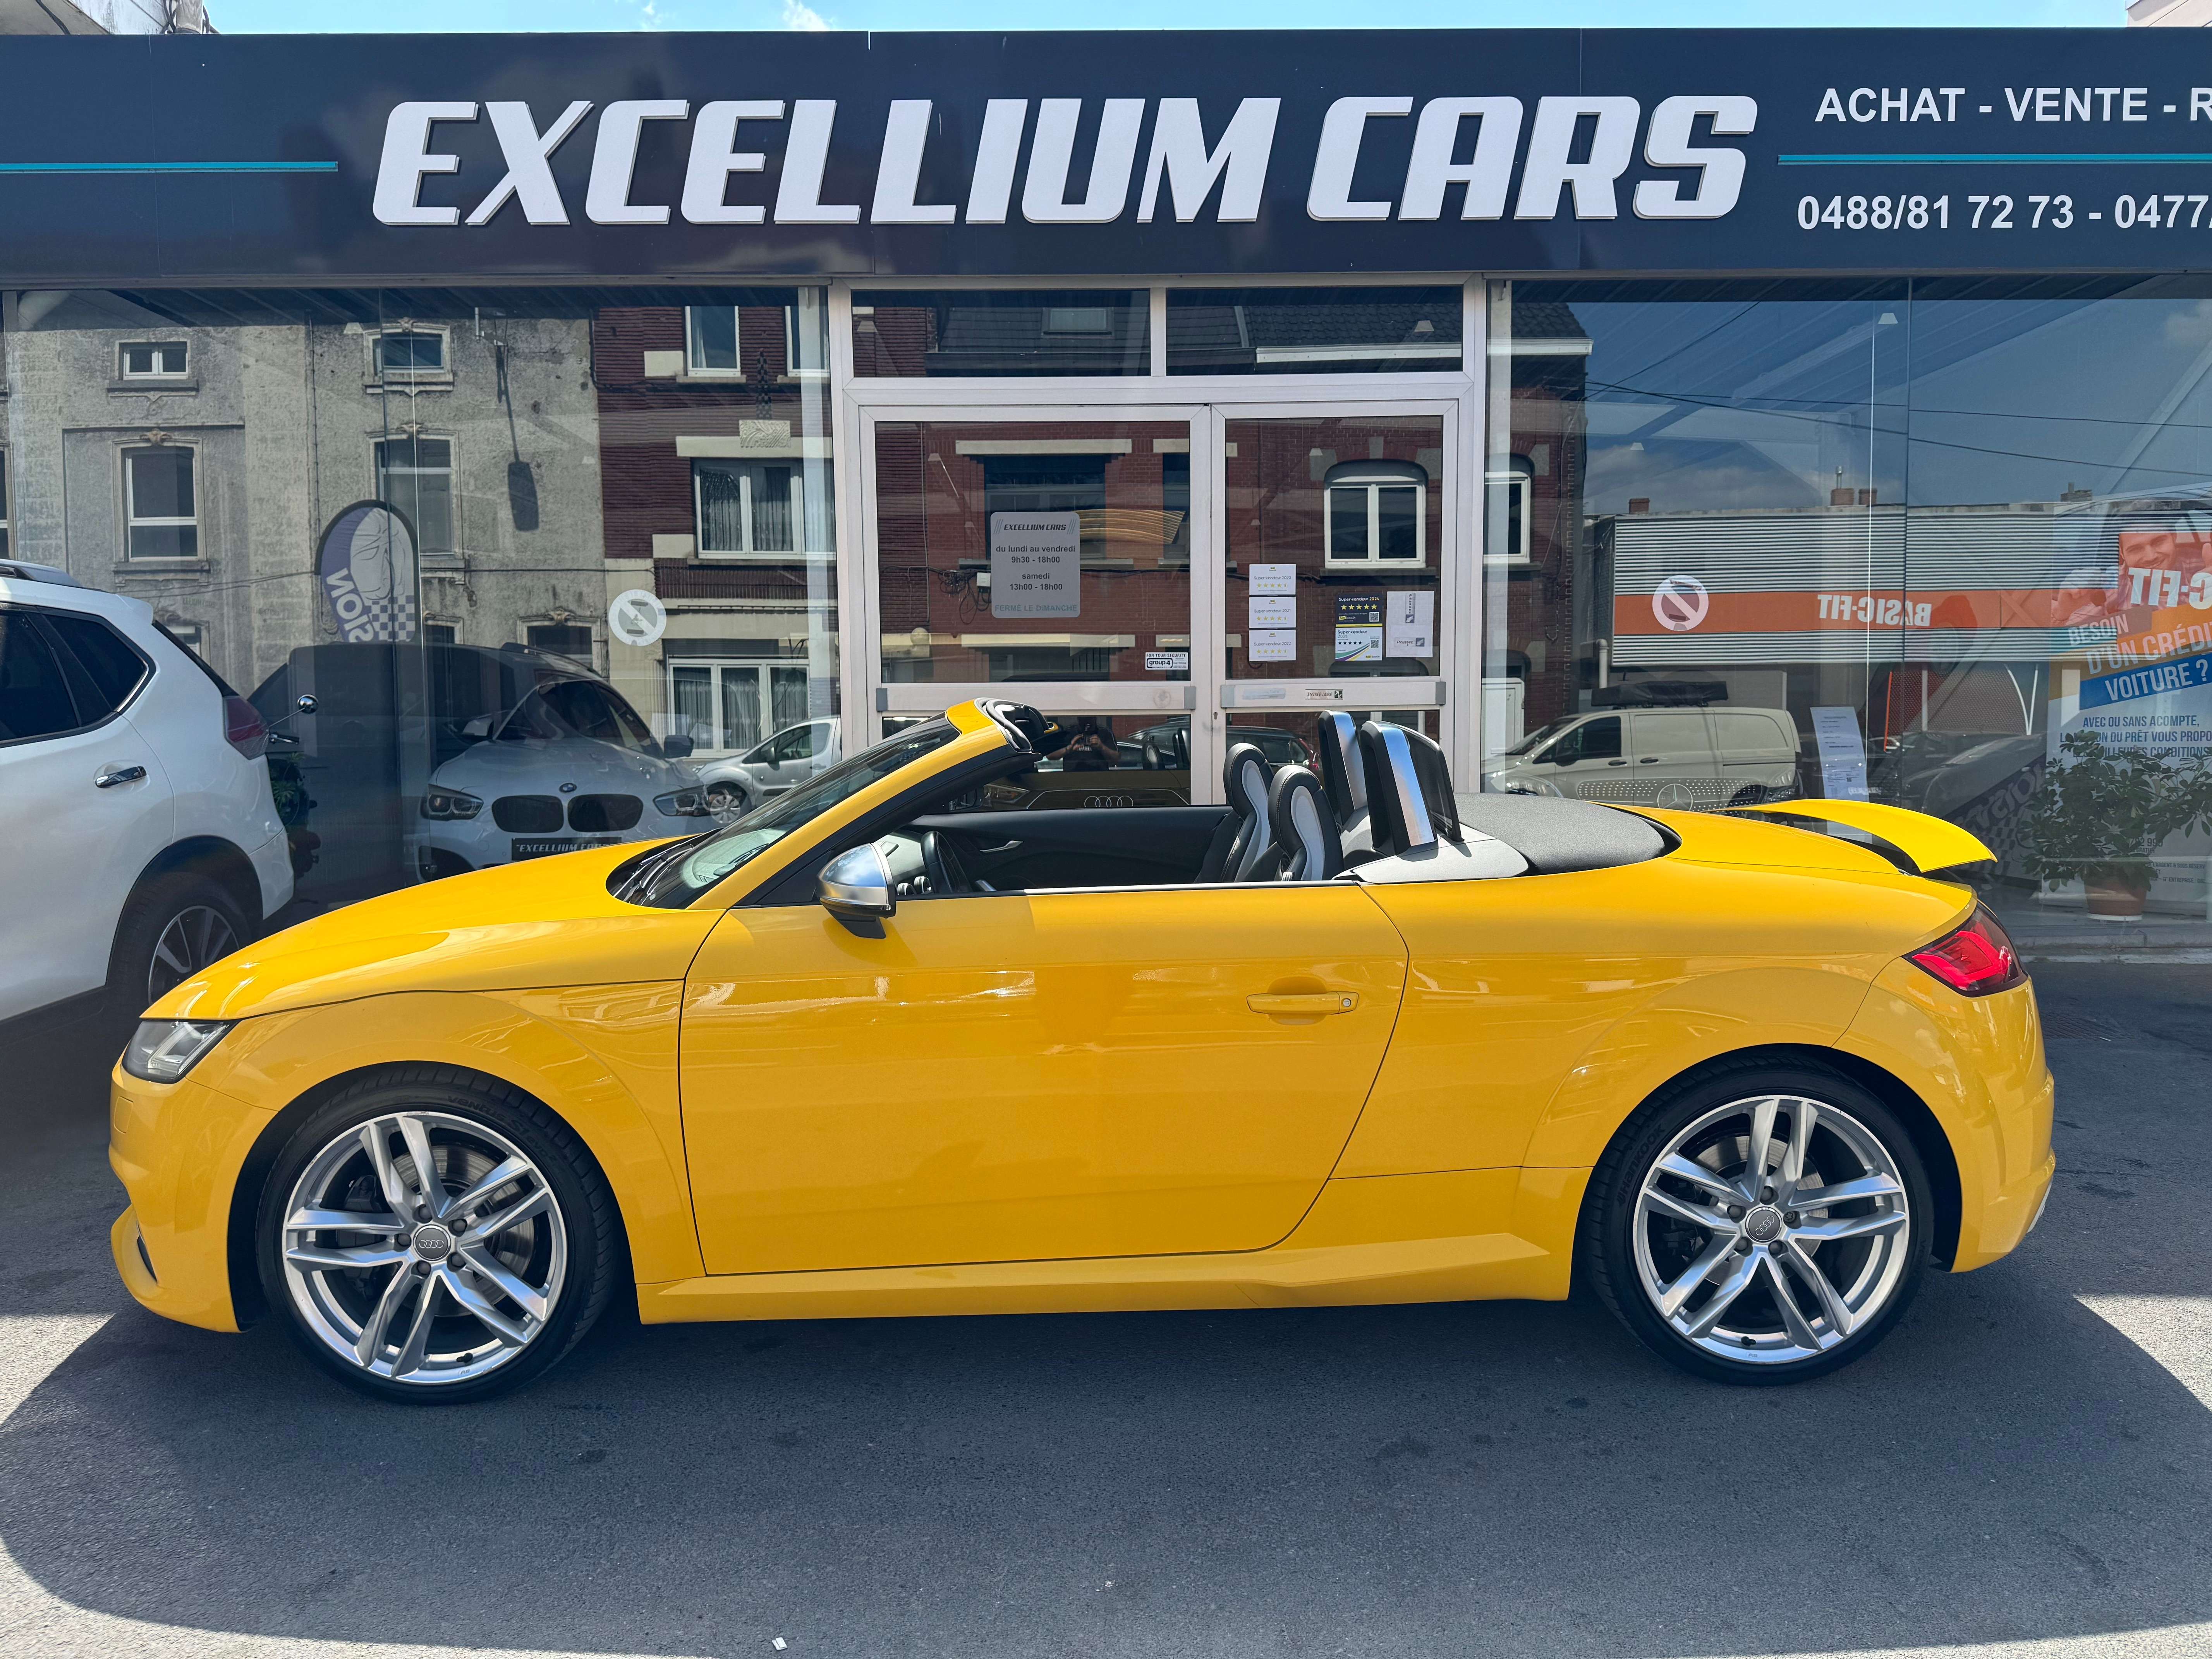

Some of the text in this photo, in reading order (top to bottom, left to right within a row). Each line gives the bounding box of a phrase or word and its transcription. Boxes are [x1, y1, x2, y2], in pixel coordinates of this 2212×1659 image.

[1815, 88, 1965, 122] ACHAT
[2004, 88, 2148, 121] VENTE
[373, 96, 1757, 225] EXCELLIUM CARS
[1797, 195, 1948, 230] 0488/81
[1967, 195, 2013, 229] 72
[2028, 195, 2074, 229] 73
[2115, 195, 2212, 228] 0477
[2068, 613, 2129, 646] BESOIN
[2142, 621, 2212, 661] CRÉDI
[2105, 663, 2193, 701] VOITURE
[2083, 717, 2106, 728] AVEC
[2109, 716, 2121, 727] OU
[2123, 716, 2147, 727] SANS
[2111, 732, 2122, 742] DU
[2125, 729, 2148, 742] PRÊT
[2152, 731, 2177, 742] VOUS
[519, 843, 578, 852] EXCELLIUM
